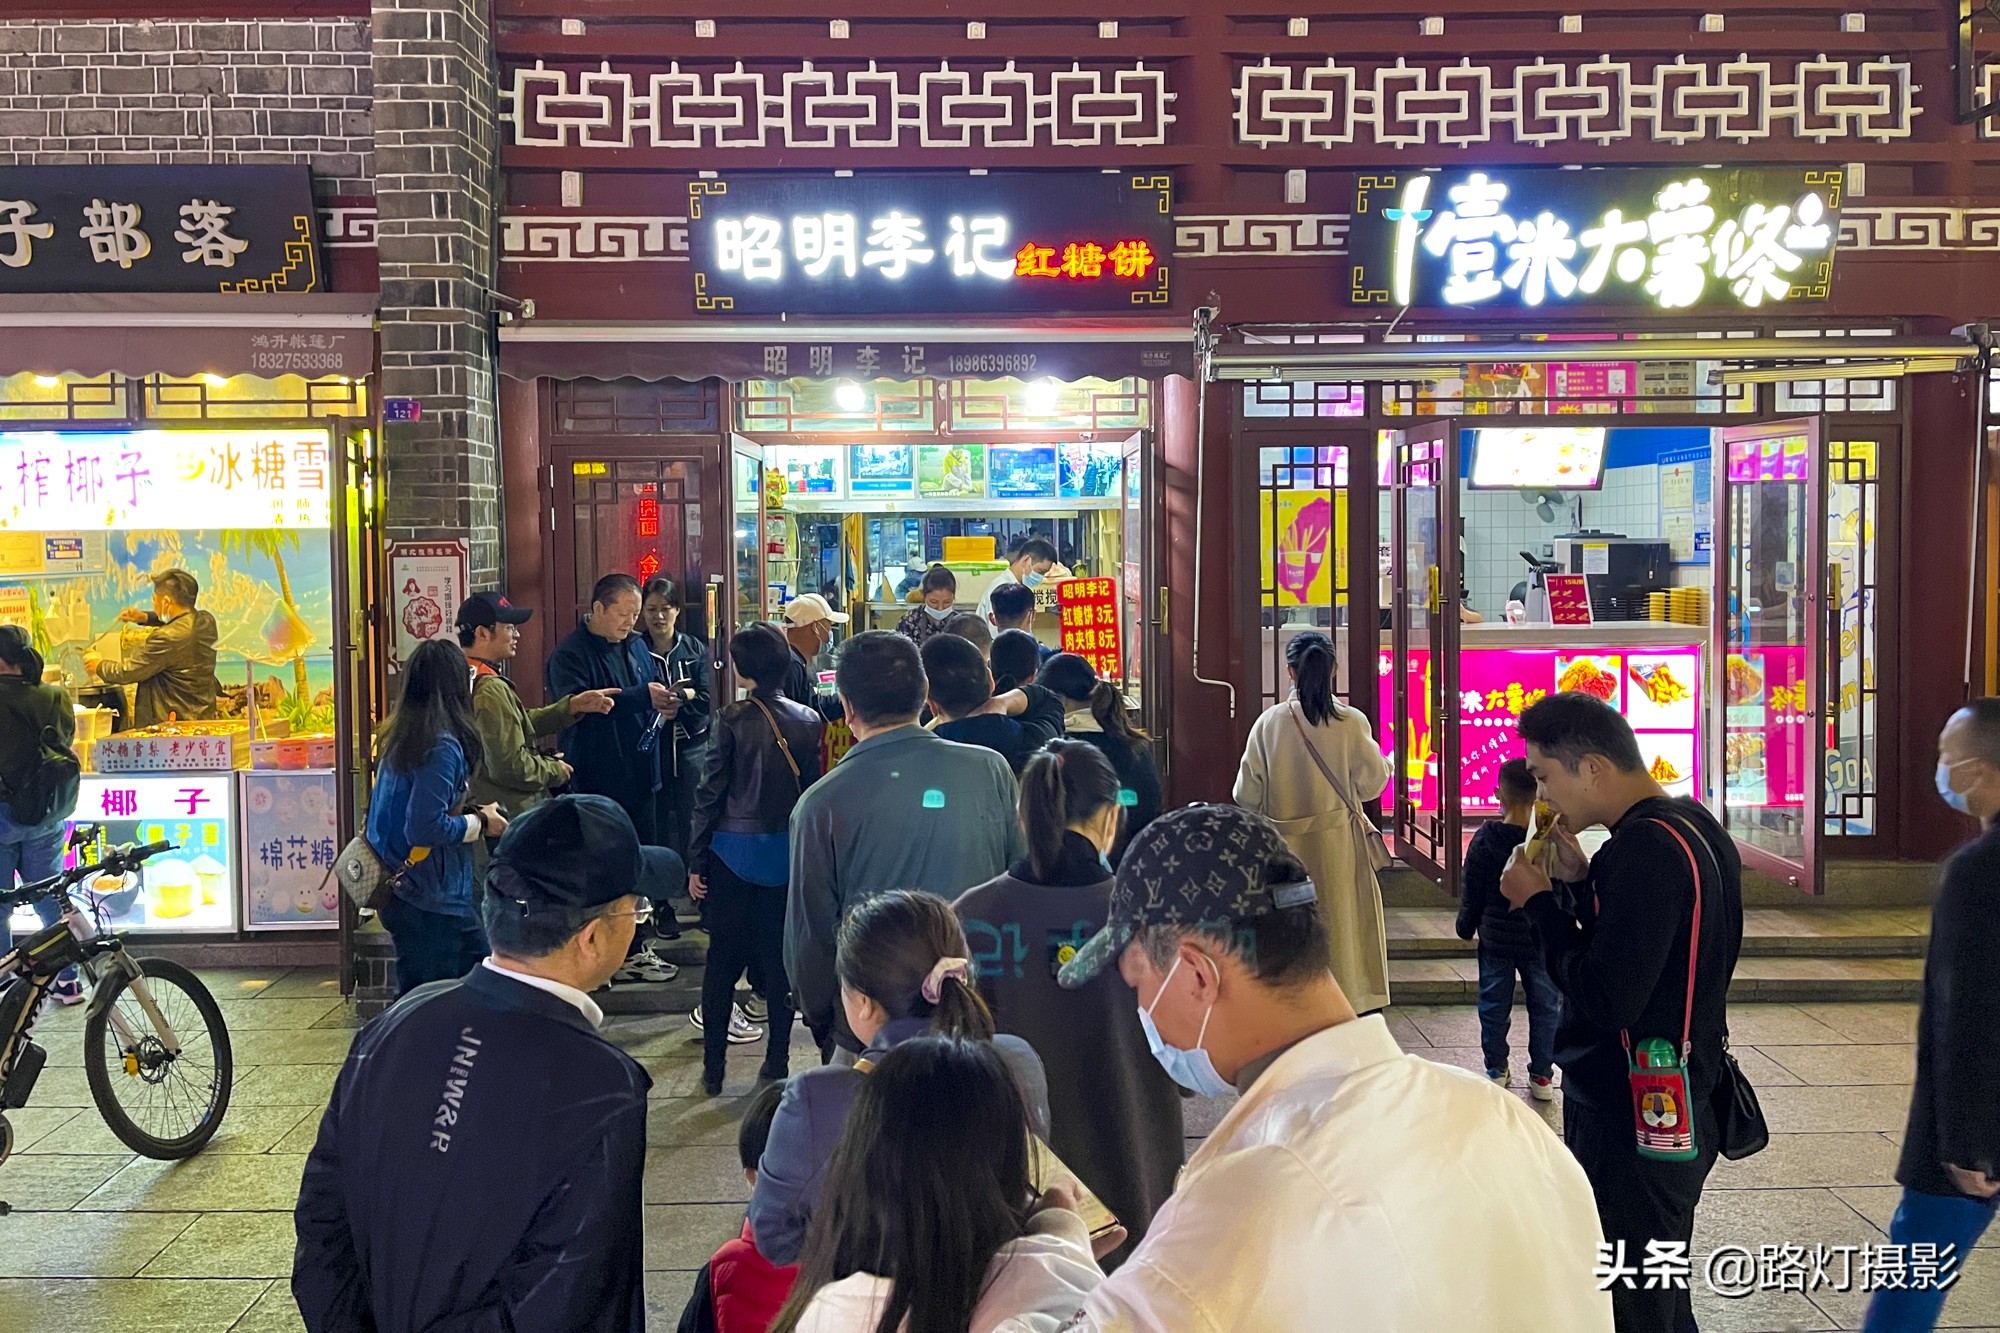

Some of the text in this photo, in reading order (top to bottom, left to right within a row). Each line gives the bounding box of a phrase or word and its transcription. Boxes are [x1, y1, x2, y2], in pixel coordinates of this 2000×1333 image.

[0, 198, 249, 269] 子部落
[715, 210, 1154, 282] 昭明李记 红糖饼
[250, 352, 343, 369] 18327533368
[763, 345, 1037, 376] 昭明李记 18986396892
[394, 410, 411, 418] 121
[210, 440, 327, 490] 冰糖雪
[1062, 580, 1110, 599] 昭明李记
[1062, 604, 1114, 627] 红糖饼 3元
[1098, 629, 1116, 648] 8元
[1100, 654, 1118, 673] 3元
[102, 740, 226, 758] 冰糖雪梨 老少皆宜
[101, 788, 210, 816] 椰子
[260, 835, 334, 871] 棉花糖
